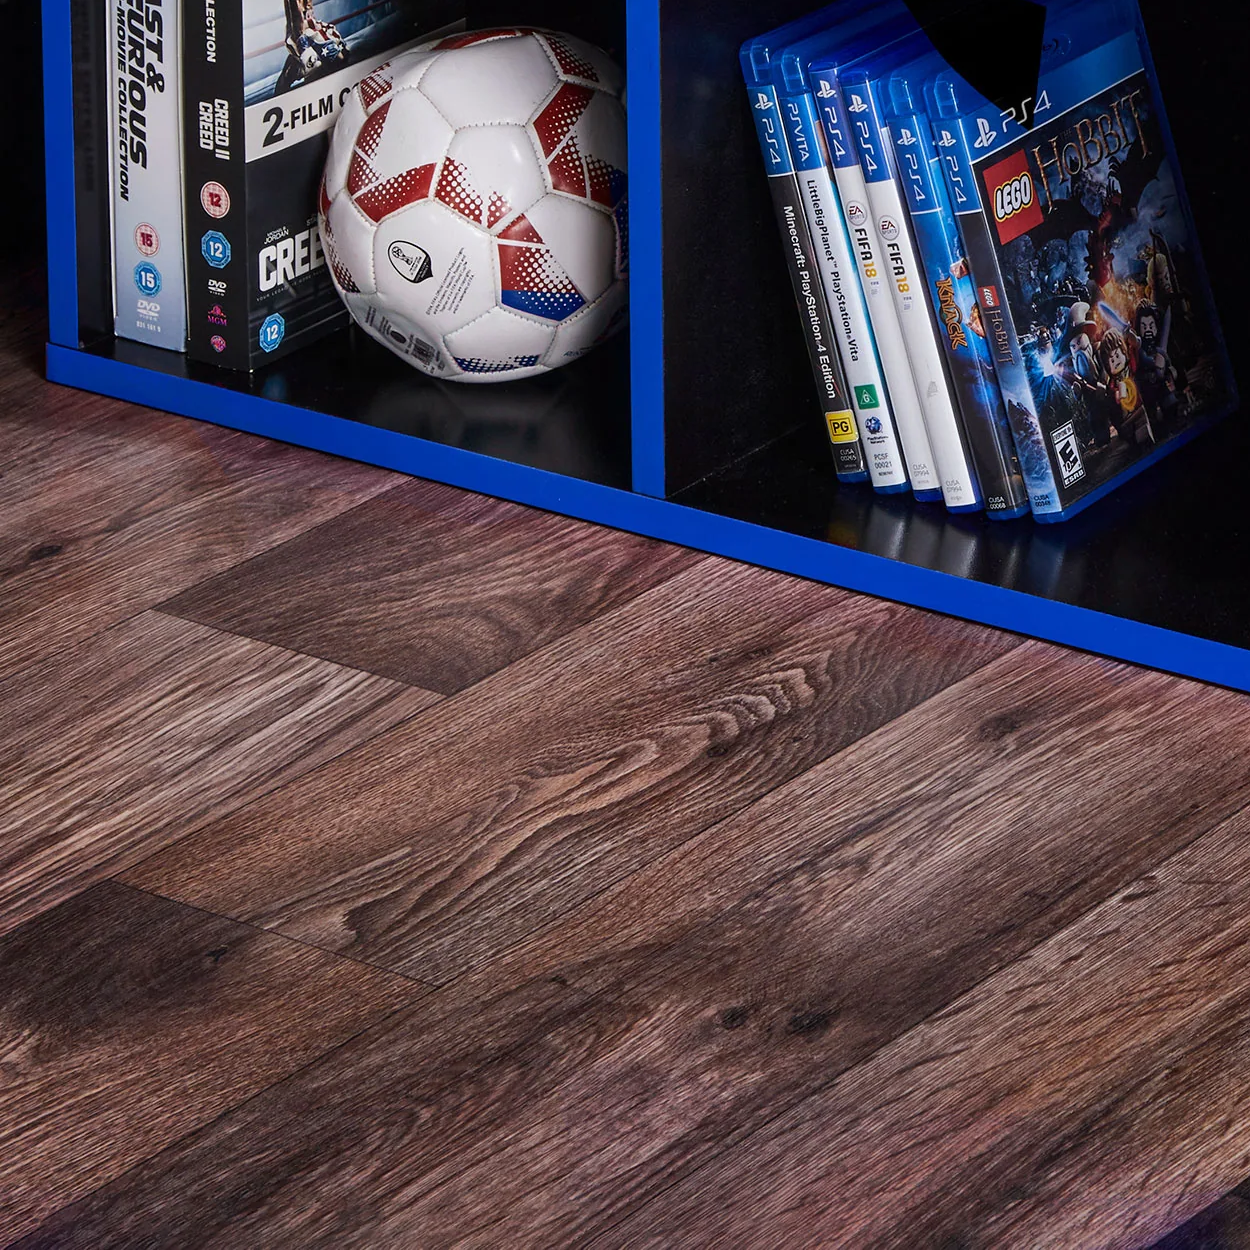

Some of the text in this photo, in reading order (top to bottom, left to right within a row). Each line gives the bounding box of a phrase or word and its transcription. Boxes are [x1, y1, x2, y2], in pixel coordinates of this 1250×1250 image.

[146, 62, 165, 94] &
[199, 101, 214, 150] CREED
[214, 98, 229, 147] CREED
[262, 93, 333, 148] 2-FILM
[1000, 90, 1052, 133] PS4
[118, 77, 129, 202] COLLECTION
[762, 117, 782, 165] PS4
[825, 106, 846, 158] PS4
[857, 121, 878, 172] PS4
[905, 153, 925, 202] PS4
[946, 155, 967, 204] PS4
[208, 191, 221, 207] 12
[849, 205, 863, 215] EA
[994, 172, 1033, 222] LEGO
[264, 229, 289, 245] JORDAN
[881, 220, 895, 230] EA
[209, 241, 223, 257] 12
[259, 226, 325, 292] CREE
[854, 228, 877, 278] FIFA 18
[887, 242, 910, 293] FIFA 18
[141, 271, 155, 288] 15
[208, 279, 227, 290] DVD
[983, 288, 994, 306] LEGO
[137, 300, 161, 312] DVD
[207, 315, 227, 326] MGM
[783, 206, 805, 268] Minecraft:
[820, 355, 836, 399] Edition
[936, 277, 968, 350] KNACK
[266, 324, 278, 342] 12
[848, 339, 859, 362] Vita
[832, 420, 849, 434] PG
[874, 461, 892, 470] 00021
[1064, 469, 1084, 485] ESRB
